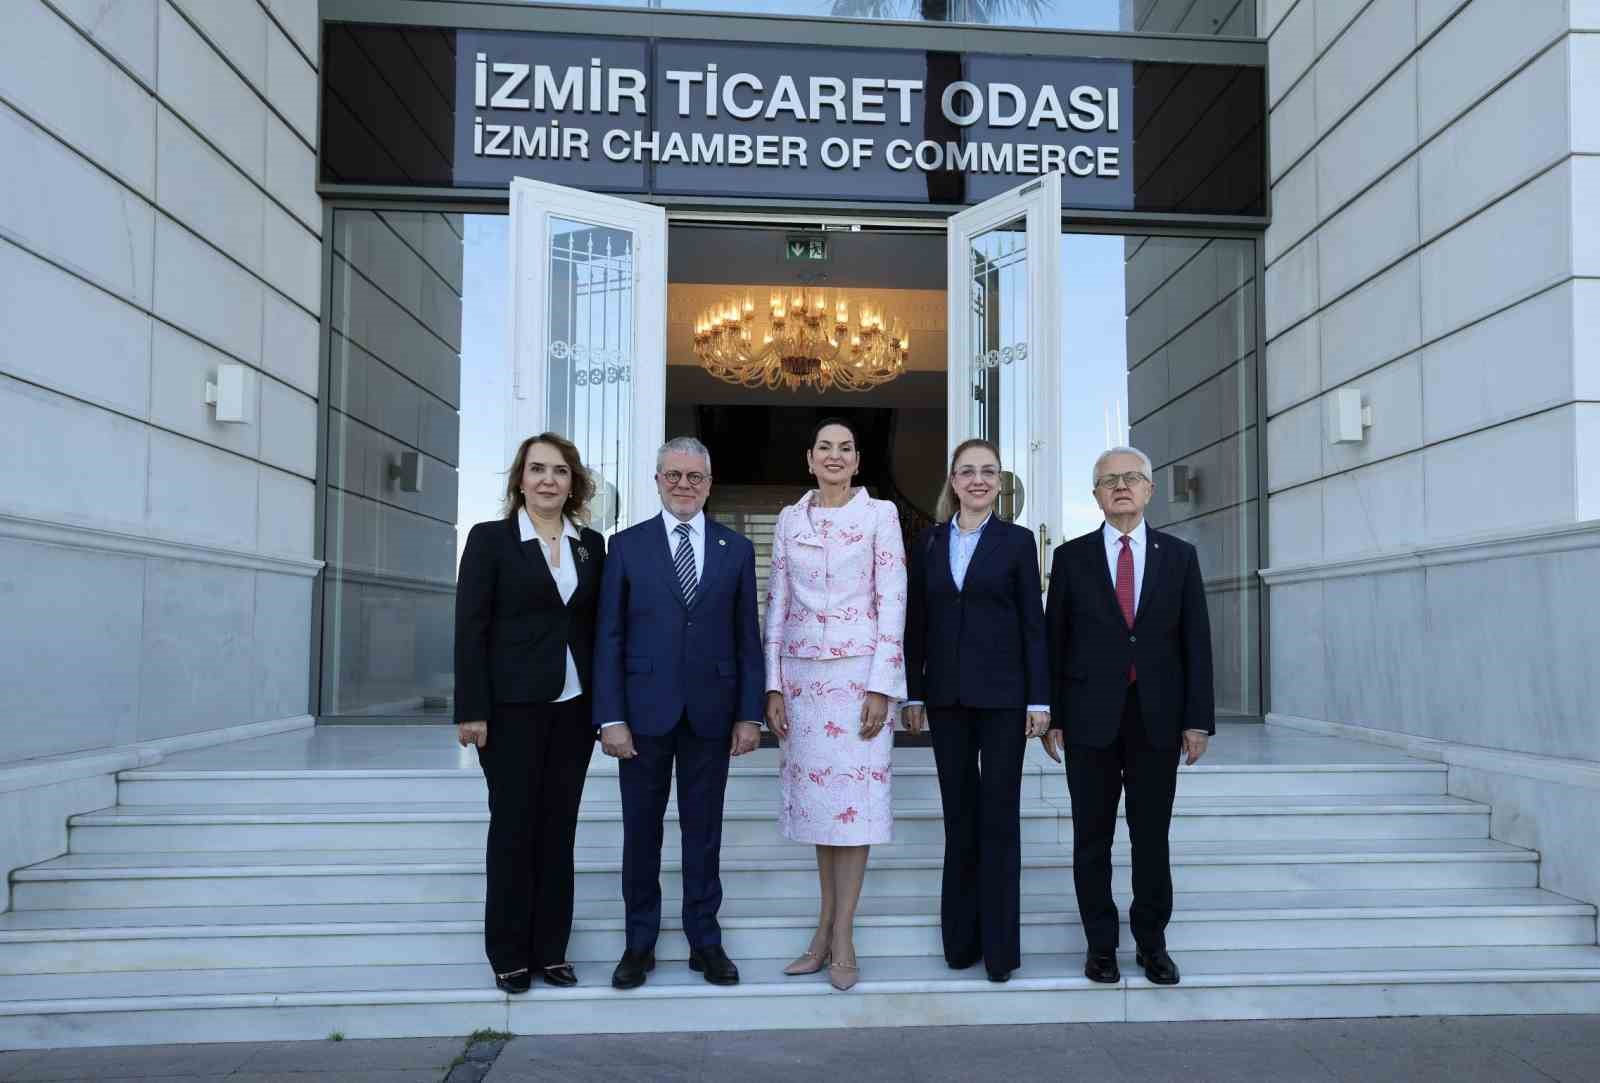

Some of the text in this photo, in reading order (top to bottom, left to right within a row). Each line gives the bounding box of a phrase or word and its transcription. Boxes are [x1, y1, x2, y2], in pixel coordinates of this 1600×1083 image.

[475, 52, 1119, 131] İZMİR TİCARET ODASI
[473, 116, 1120, 177] İZMİR CHAMBER OF COMMERCE
